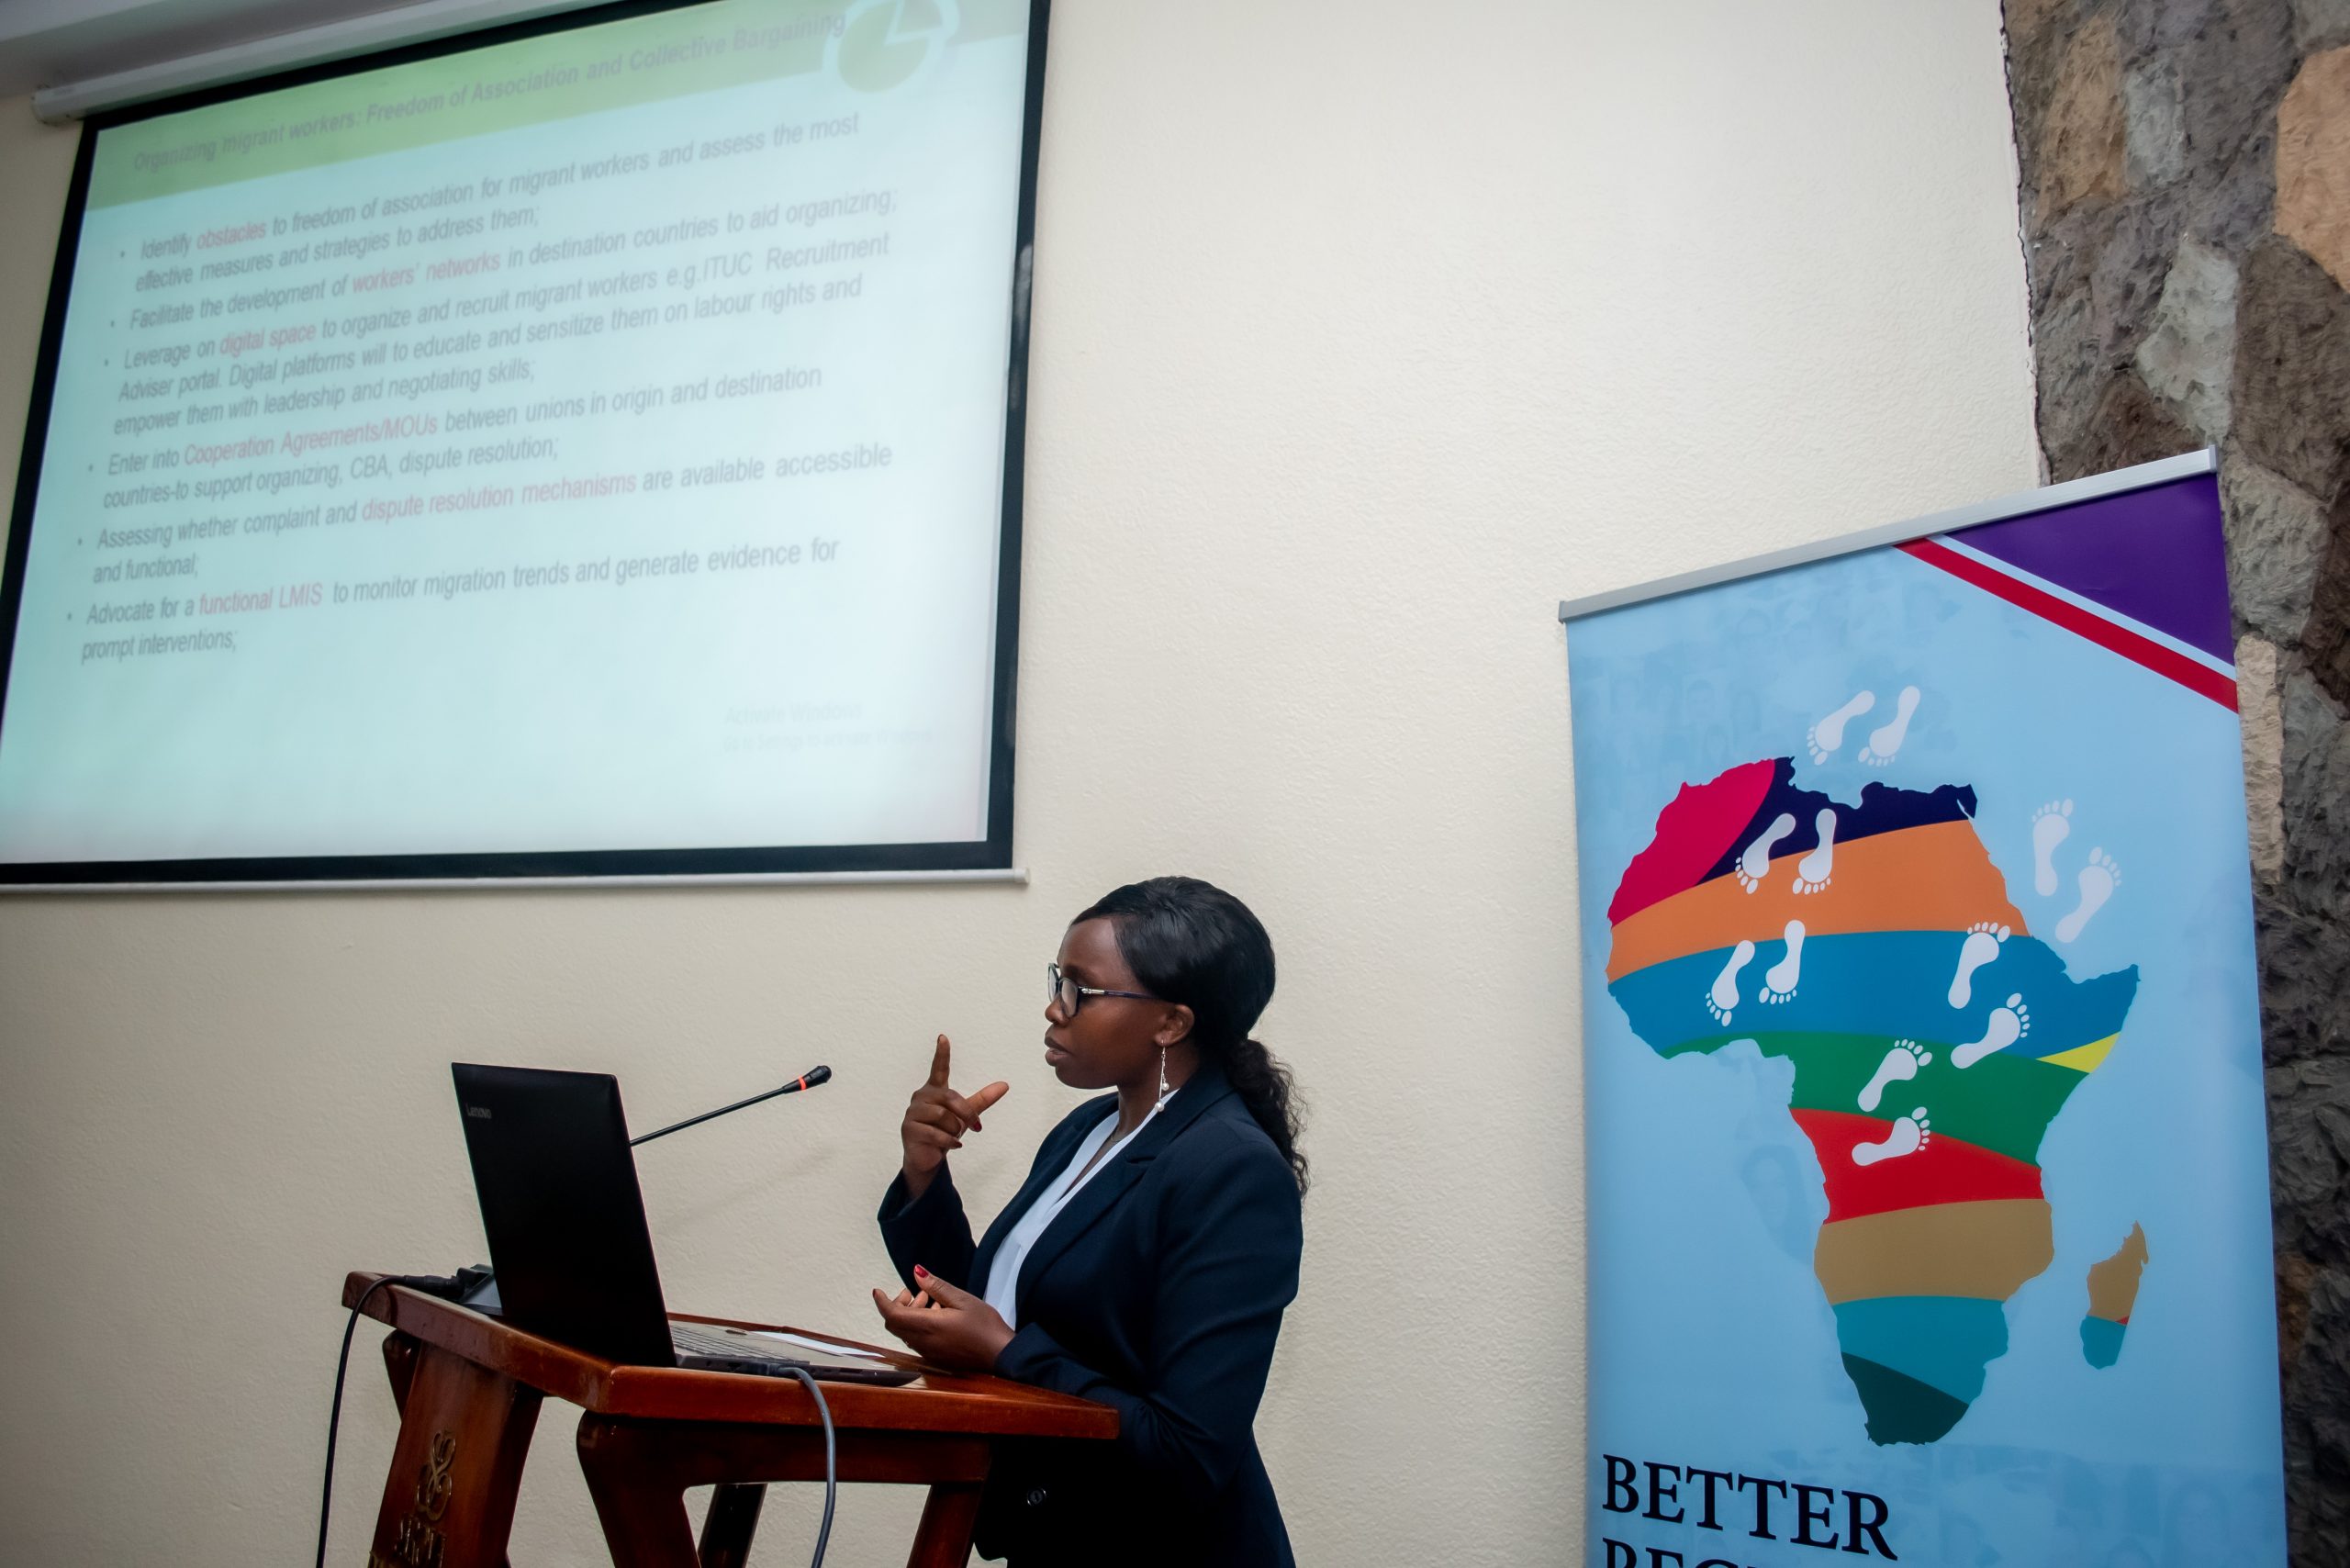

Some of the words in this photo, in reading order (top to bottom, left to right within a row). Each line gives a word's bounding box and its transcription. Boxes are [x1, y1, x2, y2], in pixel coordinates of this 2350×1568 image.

[134, 140, 217, 173] Organizing
[222, 125, 284, 155] migrant
[289, 112, 363, 140] workers:
[366, 86, 444, 123] Freedom
[450, 84, 468, 107] of
[470, 68, 578, 102] Association
[587, 54, 622, 80] and
[630, 35, 726, 72] Collective
[733, 13, 845, 51] Bargaining
[140, 233, 192, 260] Identify
[196, 220, 266, 251] obstacles
[273, 218, 287, 236] to
[292, 207, 355, 233] freedom
[362, 196, 377, 219] of
[381, 183, 474, 217] association
[481, 176, 501, 199] for
[509, 162, 576, 196] migrant
[580, 150, 650, 180] workers
[658, 140, 694, 168] and
[699, 129, 766, 161] assess
[773, 123, 803, 147] the
[810, 111, 860, 140] most
[124, 345, 191, 371] Leverage
[197, 339, 216, 357] on
[219, 328, 265, 358] digital
[269, 324, 317, 350] space
[321, 319, 337, 339] to
[341, 307, 411, 338] organize
[418, 299, 450, 325] and
[456, 290, 510, 318] recruit
[515, 277, 583, 313] migrant
[588, 265, 658, 297] workers
[766, 232, 890, 271] Recruitment
[129, 302, 195, 330] Facilitate
[200, 297, 223, 318] the
[228, 282, 326, 316] development
[331, 274, 350, 297] of
[425, 250, 501, 277] networks
[508, 247, 523, 268] in
[529, 231, 626, 266] destination
[633, 215, 719, 248] countries
[726, 211, 744, 232] to
[749, 202, 778, 230] aid
[786, 188, 898, 228] organizing;
[136, 262, 193, 292] effective
[200, 252, 274, 280] measures
[279, 243, 308, 268] and
[313, 230, 391, 263] strategies
[397, 227, 412, 246] to
[418, 213, 484, 242] address
[490, 205, 540, 231] them;
[118, 378, 173, 402] Adviser
[178, 368, 221, 398] portal.
[229, 358, 278, 389] Digital
[282, 346, 355, 380] platforms
[362, 343, 386, 366] will
[393, 342, 409, 361] to
[413, 326, 482, 359] educate
[487, 324, 521, 348] and
[526, 310, 604, 344] sensitize
[610, 307, 658, 330] them
[664, 301, 688, 322] on
[694, 291, 755, 319] labour
[761, 279, 817, 315] rights
[822, 273, 863, 302] and
[107, 449, 151, 476] Enter
[152, 447, 180, 468] into
[184, 431, 274, 467] Cooperation
[280, 415, 438, 457] Agreements/MOUs
[445, 408, 518, 432] between
[525, 395, 585, 423] unions
[590, 393, 606, 415] in
[611, 384, 664, 415] origin
[670, 375, 708, 405] and
[715, 364, 822, 399] destination
[114, 406, 182, 437] empower
[186, 401, 224, 425] them
[229, 396, 258, 419] with
[263, 378, 345, 413] leadership
[352, 375, 384, 402] and
[387, 363, 482, 400] negotiating
[488, 357, 536, 384] skills;
[97, 523, 173, 550] Assessing
[178, 516, 238, 542] whether
[243, 506, 320, 537] complaint
[325, 502, 357, 524] and
[362, 489, 424, 523] dispute
[429, 485, 514, 514] resolution
[521, 471, 637, 506] mechanisms
[643, 469, 673, 492] are
[680, 457, 766, 487] available
[776, 442, 893, 477] accessible
[194, 473, 252, 501] support
[257, 461, 343, 497] organizing,
[350, 454, 393, 479] CBA,
[399, 444, 461, 478] dispute
[468, 436, 559, 466] resolution;
[86, 599, 155, 625] Advocate
[160, 598, 179, 618] for
[185, 598, 195, 615] a
[199, 588, 274, 615] functional
[279, 582, 323, 609] LMIS
[333, 583, 349, 603] to
[353, 575, 418, 603] monitor
[423, 567, 506, 600] migration
[512, 562, 570, 589] trends
[576, 556, 610, 583] and
[615, 550, 699, 585] generate
[708, 542, 802, 572] evidence
[811, 535, 839, 563] for
[93, 562, 121, 584] and
[126, 553, 199, 579] functional;
[82, 633, 135, 665] prompt
[139, 628, 239, 655] interventions;
[466, 1104, 492, 1119] Lenovo
[1603, 1454, 1898, 1562] BETTER
